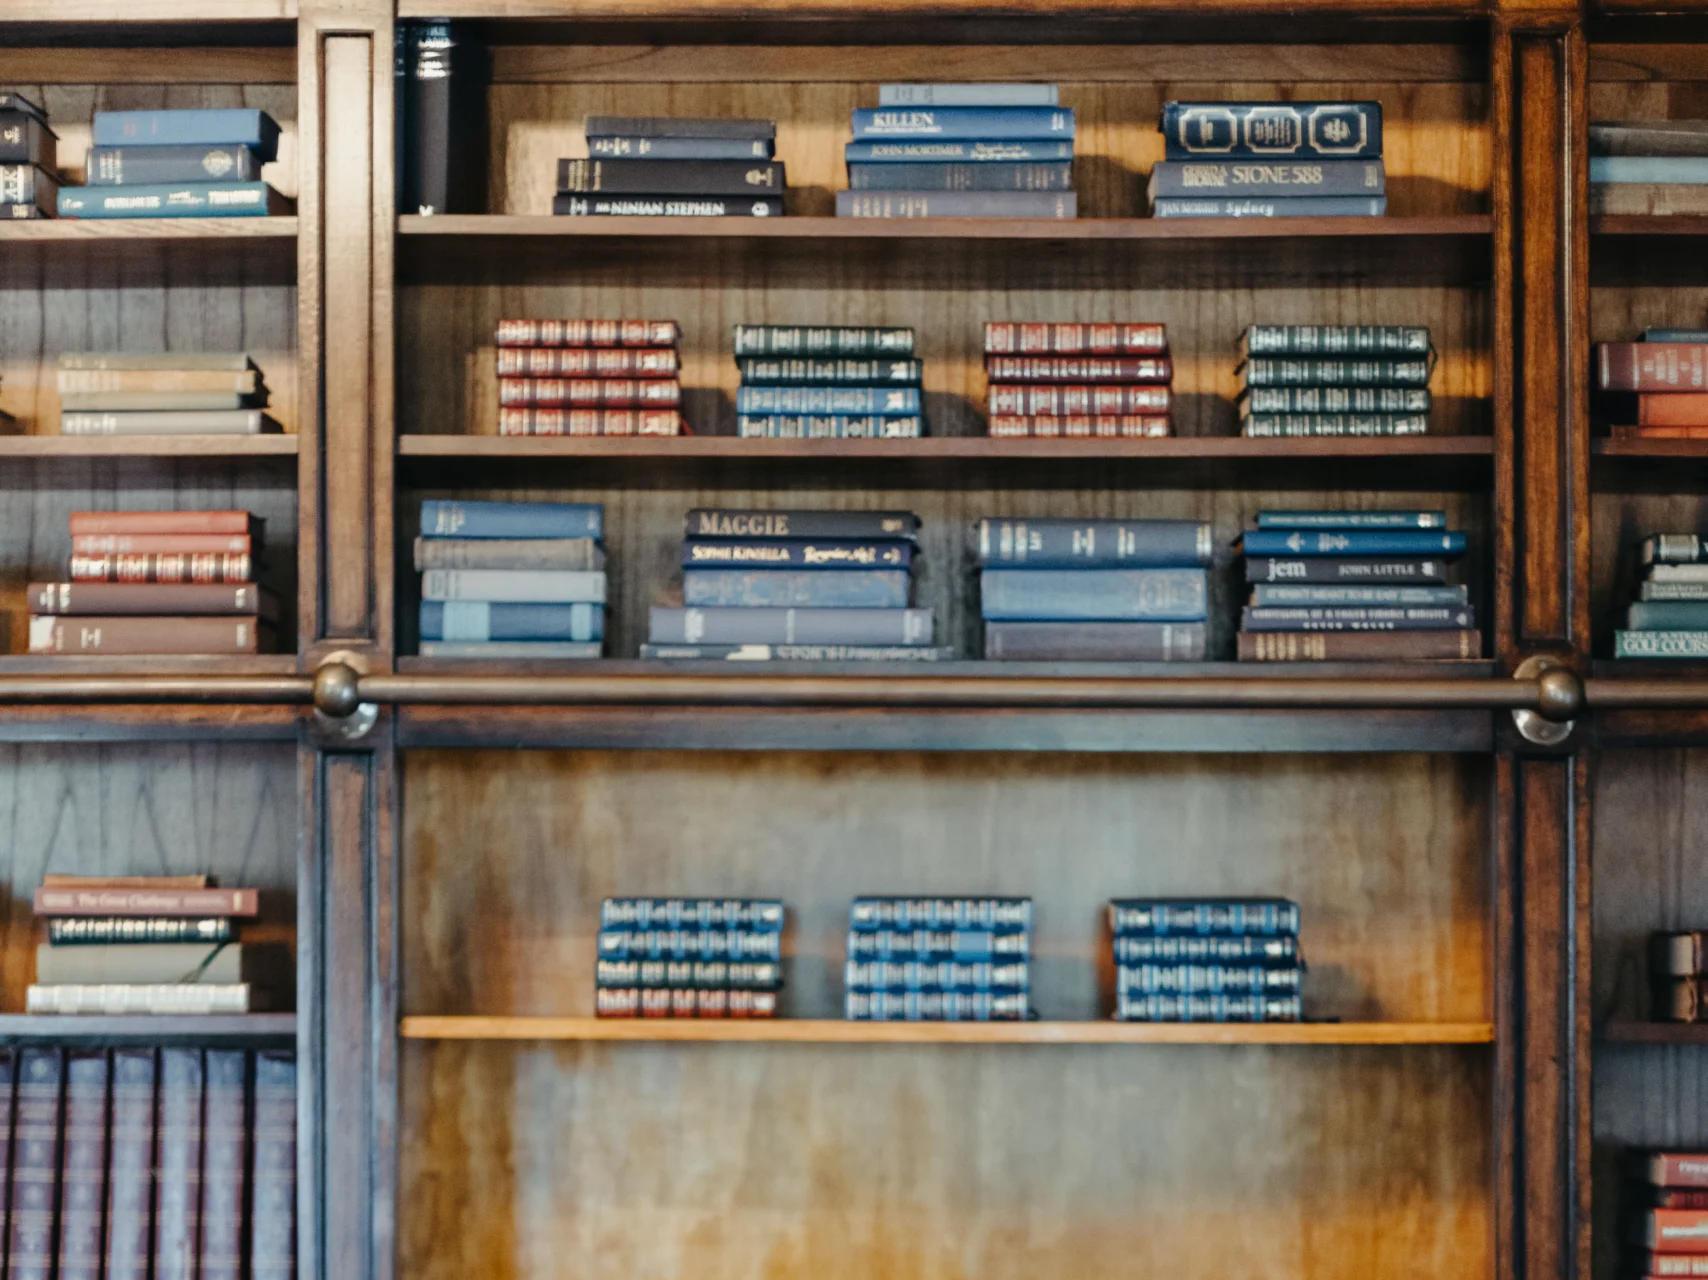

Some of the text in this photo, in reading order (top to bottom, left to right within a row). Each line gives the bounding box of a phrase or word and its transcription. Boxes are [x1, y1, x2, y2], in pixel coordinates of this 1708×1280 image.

[873, 112, 934, 127] KILLEN
[1232, 166, 1323, 185] STONE 588
[611, 201, 664, 215] NINIAN
[665, 201, 725, 215] STEPHEN
[1225, 201, 1275, 217] Sydney
[699, 512, 790, 535] MAGGIE
[1268, 559, 1415, 582] jem JOHN LITTLE
